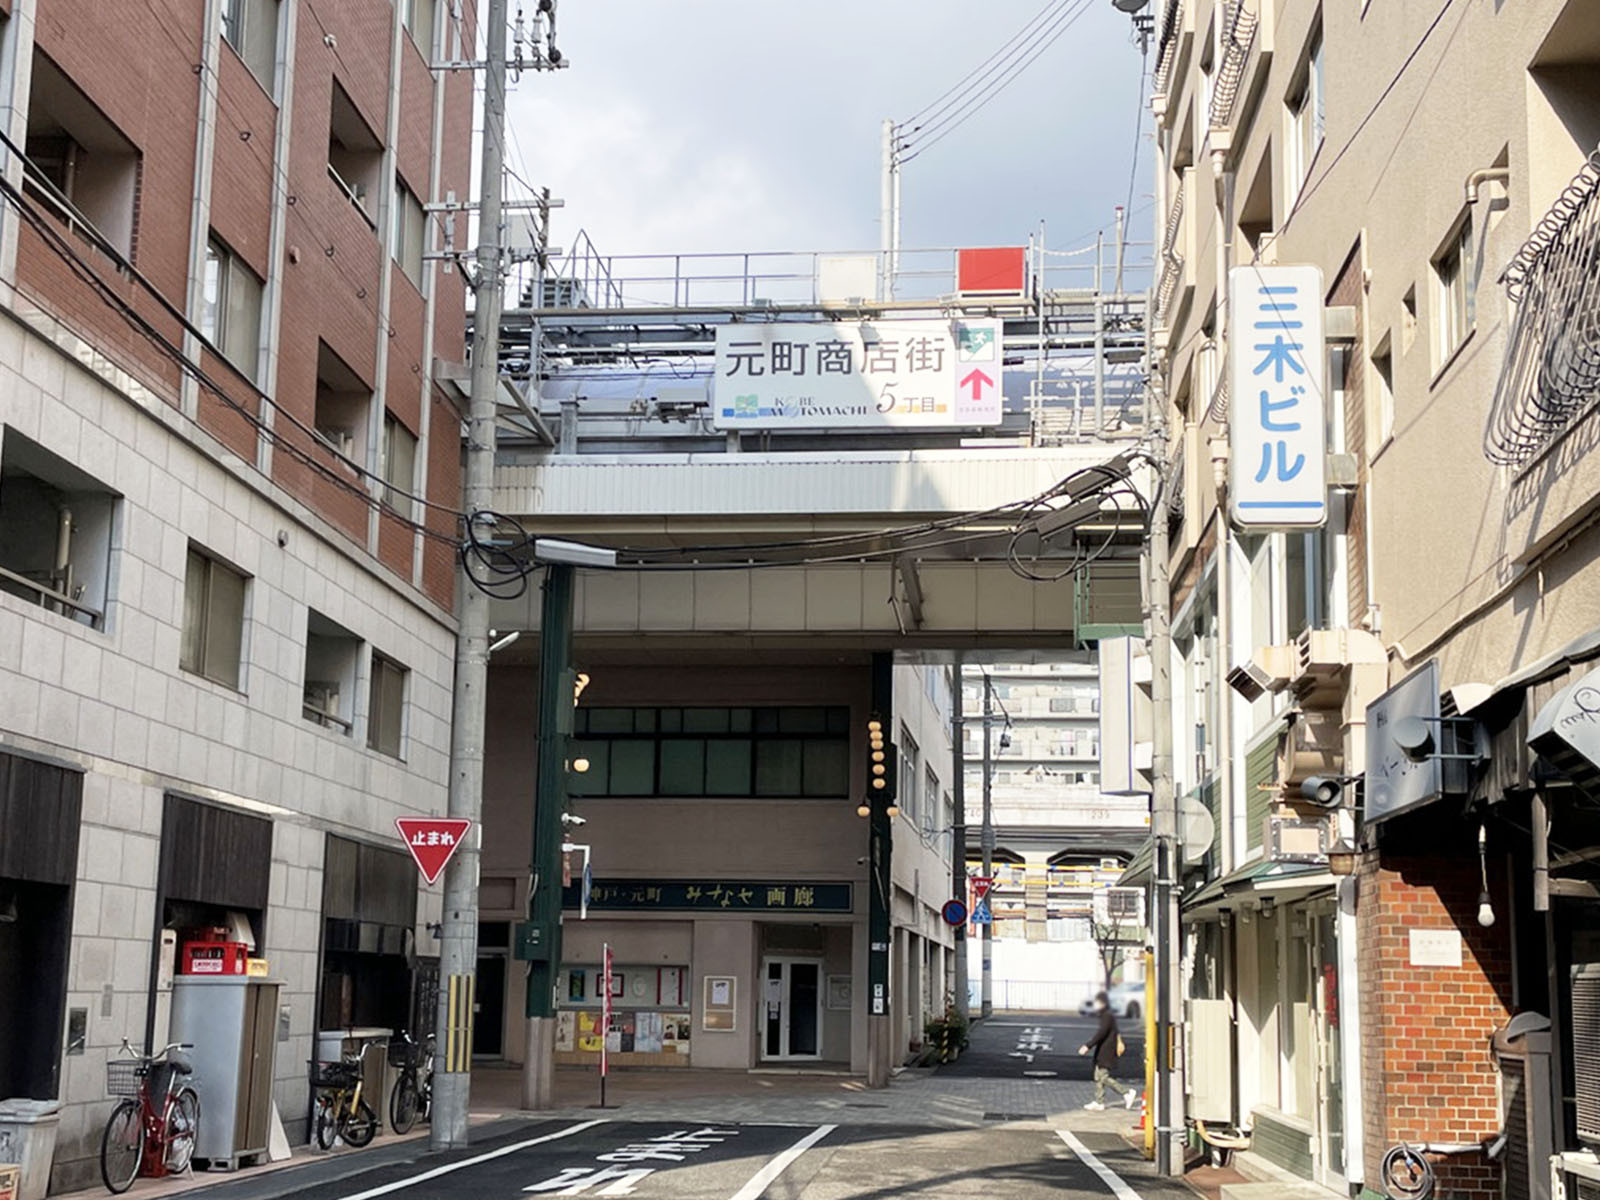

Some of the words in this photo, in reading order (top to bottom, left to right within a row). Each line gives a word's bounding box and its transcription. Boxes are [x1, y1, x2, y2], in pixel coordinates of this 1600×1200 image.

[725, 337, 945, 377] 元町商店街
[1252, 286, 1306, 484] 三木ビル
[411, 830, 455, 846] 止まれ
[521, 1126, 741, 1197] 止まれ
